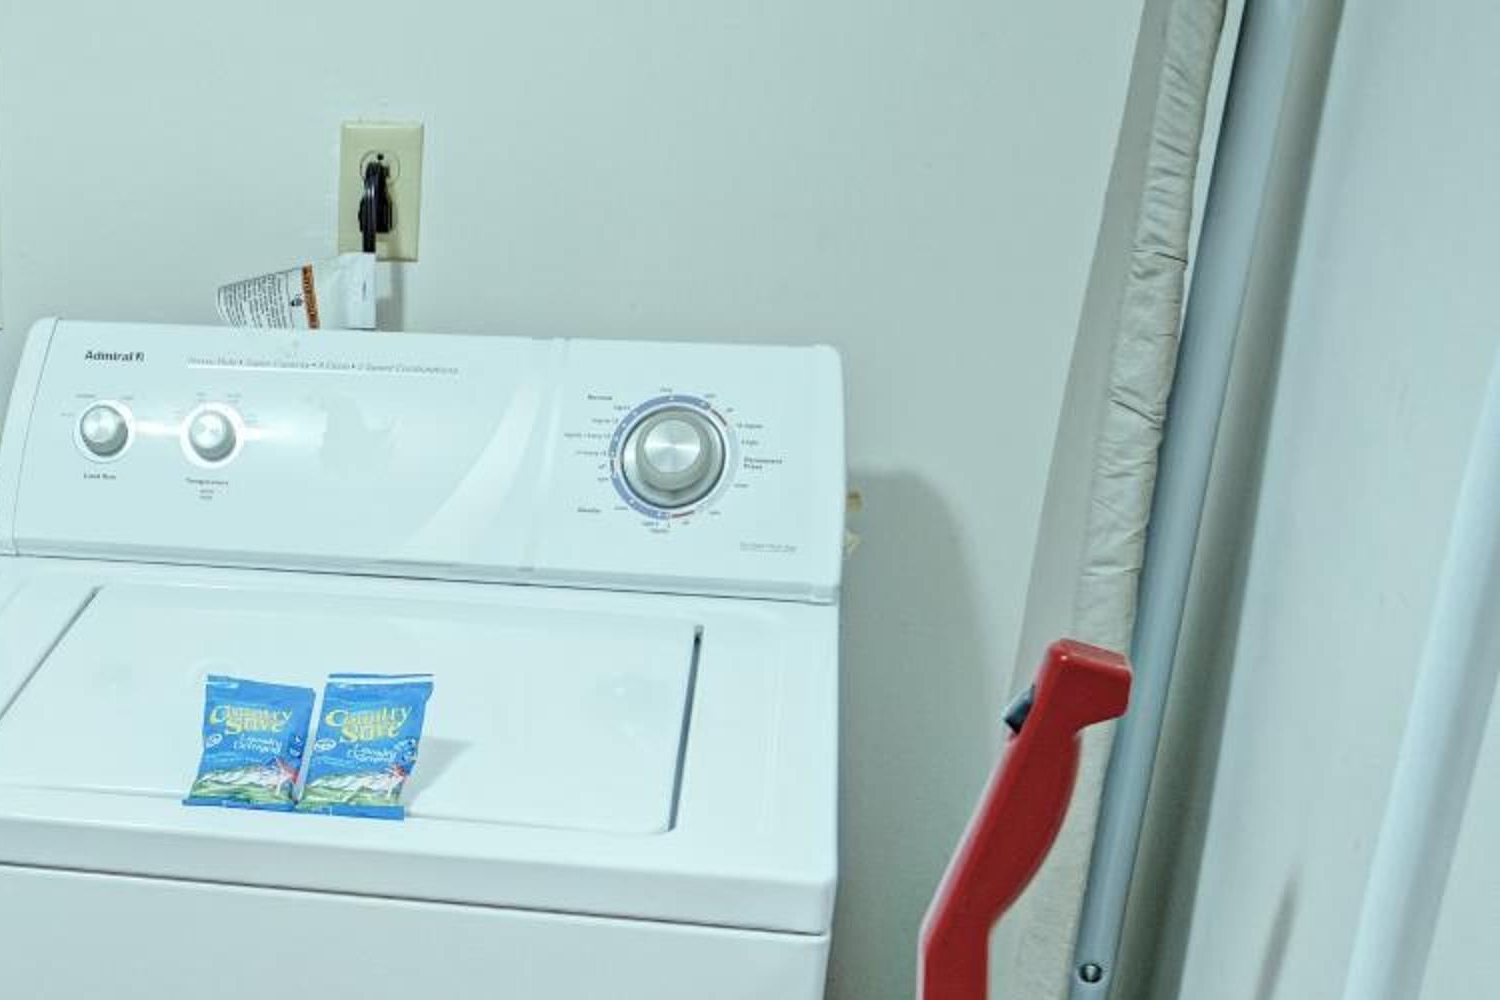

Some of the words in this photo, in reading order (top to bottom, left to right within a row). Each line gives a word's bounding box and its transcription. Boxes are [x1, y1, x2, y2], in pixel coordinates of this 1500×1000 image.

[84, 349, 133, 361] Admiral
[209, 704, 293, 725] Country
[325, 703, 413, 728] Country
[224, 718, 285, 735] Save
[340, 722, 402, 743] Save
